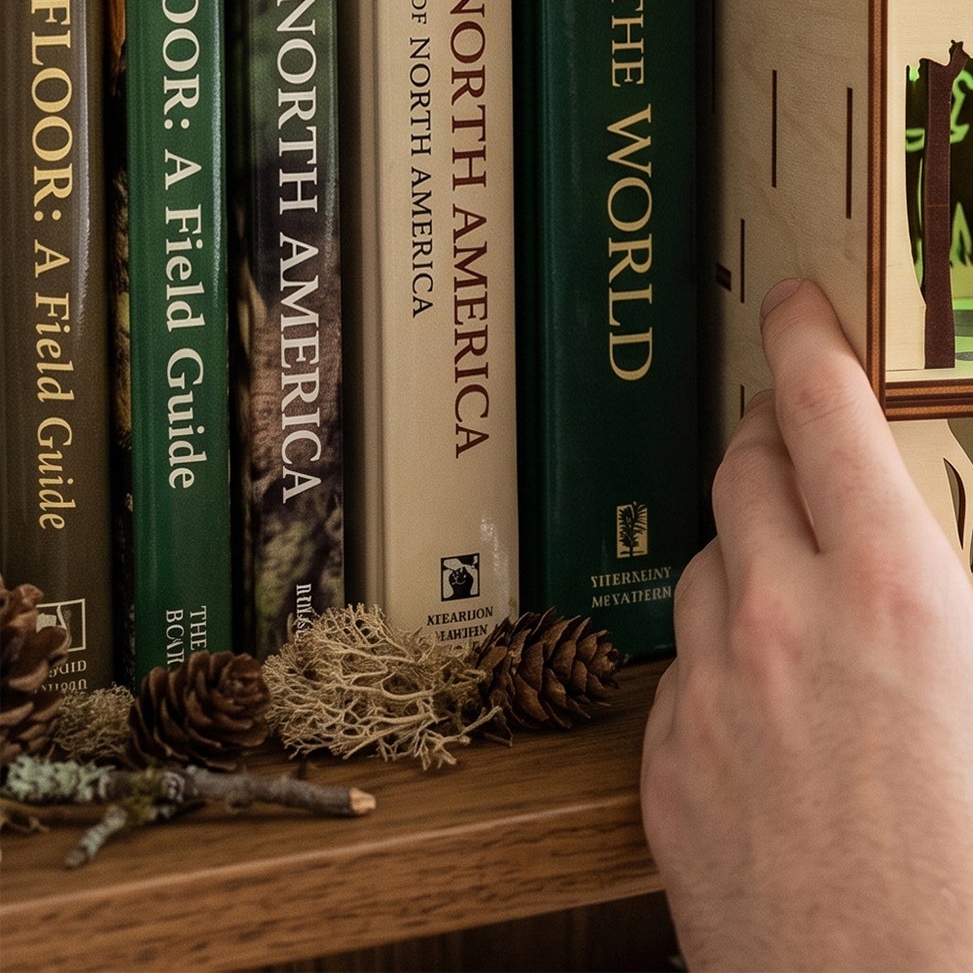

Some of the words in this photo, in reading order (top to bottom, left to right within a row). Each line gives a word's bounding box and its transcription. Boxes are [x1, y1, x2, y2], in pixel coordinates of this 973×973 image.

[409, 35, 432, 156] NORTH
[164, 148, 202, 192] A
[34, 238, 69, 278] A
[165, 206, 206, 332] Field
[410, 166, 434, 318] AMERICA
[606, 104, 653, 383] WORLD
[35, 292, 76, 404] Field
[279, 232, 323, 504] AMERICA
[452, 203, 492, 460] AMERICA
[36, 417, 79, 531] Guide
[166, 347, 208, 490] Guide
[190, 606, 208, 651] THE
